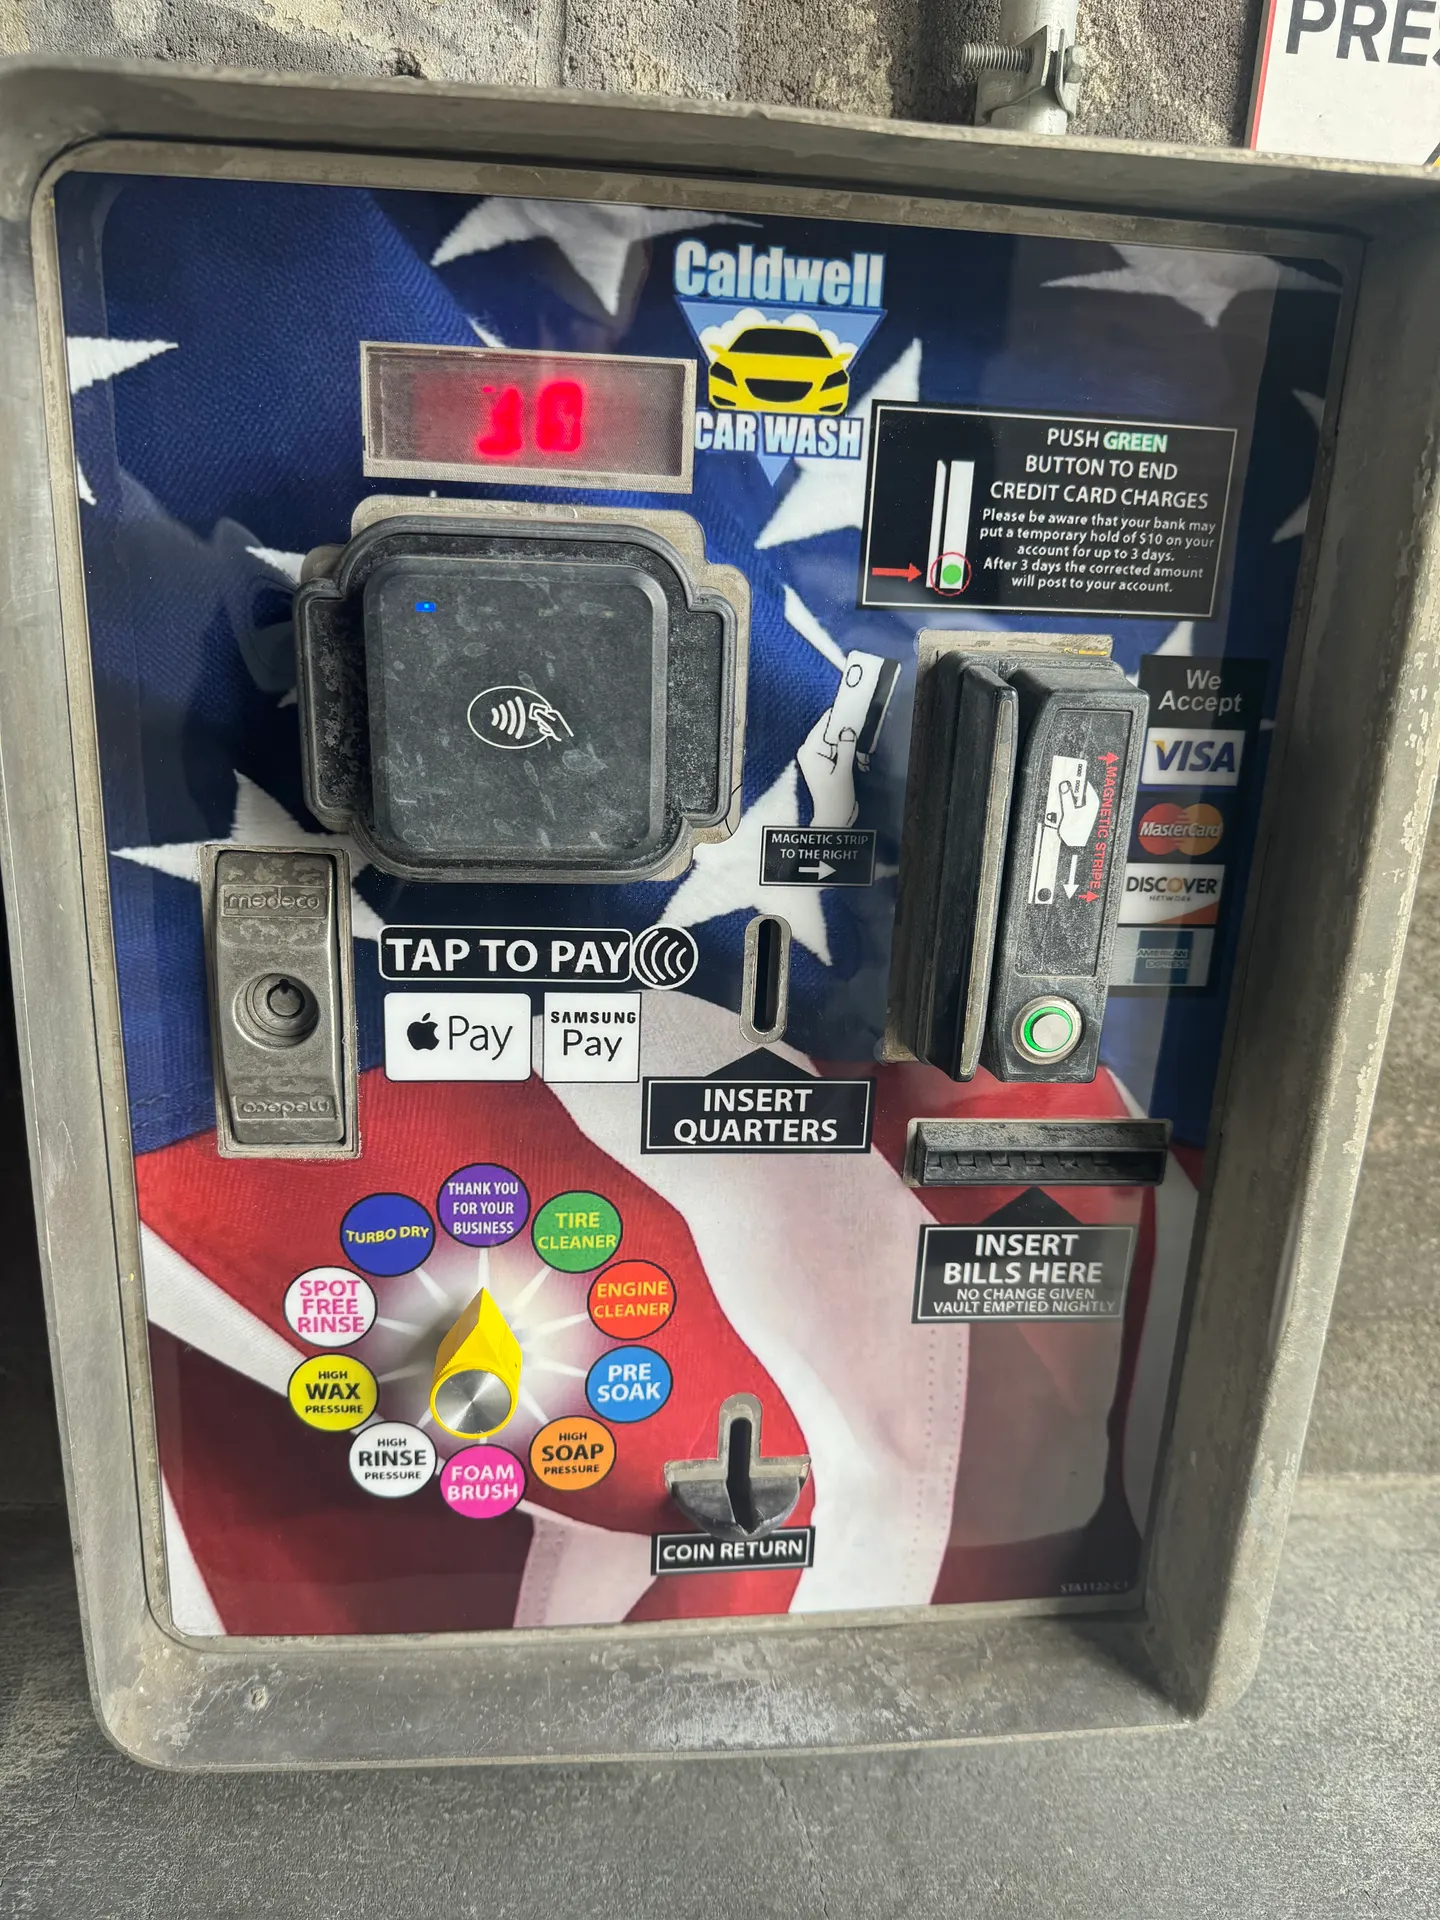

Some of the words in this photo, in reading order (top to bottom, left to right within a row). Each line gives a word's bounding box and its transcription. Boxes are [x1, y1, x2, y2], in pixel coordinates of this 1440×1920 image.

[1285, 0, 1440, 67] PRE
[674, 239, 885, 308] Caldwell
[695, 412, 757, 451] CAR
[764, 418, 861, 458] WASH
[1047, 427, 1100, 448] PUSH
[1102, 430, 1168, 453] GREEN
[1025, 454, 1104, 476] BUTTON
[1109, 459, 1134, 478] TO
[1138, 461, 1178, 480] END
[990, 480, 1060, 501] CREDIT
[1063, 484, 1117, 505] CARD
[1120, 488, 1209, 509] CHARGES
[982, 508, 1025, 522] Please
[1028, 509, 1045, 523] be
[1048, 514, 1088, 525] aware
[1091, 513, 1119, 527] that
[1120, 517, 1151, 530] your
[1153, 516, 1186, 530] bank
[1188, 521, 1216, 535] may
[979, 526, 1004, 540] put
[1005, 530, 1014, 538] a
[1017, 527, 1088, 545] temporary
[1089, 529, 1120, 543] hold
[1122, 531, 1138, 544] of
[1139, 532, 1163, 545] $10
[1165, 536, 1182, 546] on
[1184, 537, 1215, 550] your
[1016, 544, 1070, 557] account
[1072, 544, 1091, 557] for
[1093, 548, 1112, 561] up
[1113, 548, 1128, 559] to
[1130, 548, 1139, 560] 3
[1141, 548, 1175, 564] days.
[983, 556, 1018, 570] After
[1020, 559, 1029, 571] 3
[1031, 558, 1062, 575] days
[1064, 560, 1086, 573] the
[1088, 563, 1151, 576] corrected
[1153, 568, 1204, 579] amount
[1011, 574, 1036, 587] will
[1037, 576, 1067, 591] post
[1069, 577, 1083, 589] to
[1085, 580, 1117, 593] your
[1118, 581, 1174, 593] account.
[1186, 669, 1222, 690] We
[1158, 690, 1243, 716] Accept
[1151, 739, 1236, 773] VISA
[1096, 766, 1118, 839] MAGNETIC
[771, 833, 833, 845] MAGNETIC
[836, 834, 869, 845] STRIP
[1139, 821, 1224, 838] MasterCard
[780, 849, 796, 859] TO
[798, 849, 820, 860] THE
[822, 850, 859, 860] RIGHT
[1089, 842, 1107, 889] STRIPE
[1126, 876, 1218, 894] DISCOVER
[226, 887, 322, 911] medeco
[386, 939, 470, 971] TAP
[479, 940, 538, 973] TO
[551, 941, 628, 973] PAY
[550, 1011, 636, 1024] SAMSUNG
[448, 1015, 513, 1061] Pay
[562, 1029, 622, 1062] Pay
[243, 1099, 330, 1118] medeco
[703, 1088, 813, 1112] INSERT
[673, 1118, 838, 1145] QUARTERS
[448, 1182, 491, 1195] THANK
[493, 1182, 519, 1195] YOU
[453, 1202, 478, 1214] FOR
[480, 1202, 515, 1215] YOUR
[453, 1221, 514, 1235] BUSINESS
[555, 1212, 600, 1229] TIRE
[346, 1227, 396, 1244] TURBO
[399, 1226, 430, 1241] DRY
[537, 1234, 617, 1251] CLEANER
[974, 1234, 1080, 1256] INSERT
[943, 1262, 1021, 1284] BILLS
[1029, 1262, 1103, 1284] HERE
[299, 1279, 361, 1298] SPOT
[596, 1281, 669, 1299] ENGINE
[956, 1288, 979, 1300] NO
[983, 1288, 1047, 1300] CHANGE
[1050, 1288, 1095, 1300] GIVEN
[302, 1299, 359, 1316] FREE
[593, 1302, 671, 1319] CLEANER
[933, 1301, 981, 1314] VAULT
[983, 1301, 1049, 1313] EMPTIED
[1052, 1301, 1116, 1313] NIGHTLY
[297, 1316, 366, 1334] RINSE
[318, 1369, 349, 1380] HIGH
[608, 1363, 652, 1382] PRE
[305, 1382, 362, 1401] WAX
[597, 1382, 662, 1403] SOAK
[305, 1403, 364, 1415] PRESSURE
[377, 1436, 408, 1448] HIGH
[559, 1431, 588, 1443] HIGH
[358, 1449, 428, 1468] RINSE
[541, 1444, 605, 1463] SOAP
[364, 1470, 422, 1482] PRESSURE
[451, 1464, 515, 1483] FOAM
[543, 1463, 601, 1476] PRESSURE
[447, 1484, 518, 1503] BRUSH
[662, 1543, 715, 1561] COIN
[720, 1539, 803, 1559] RETURN
